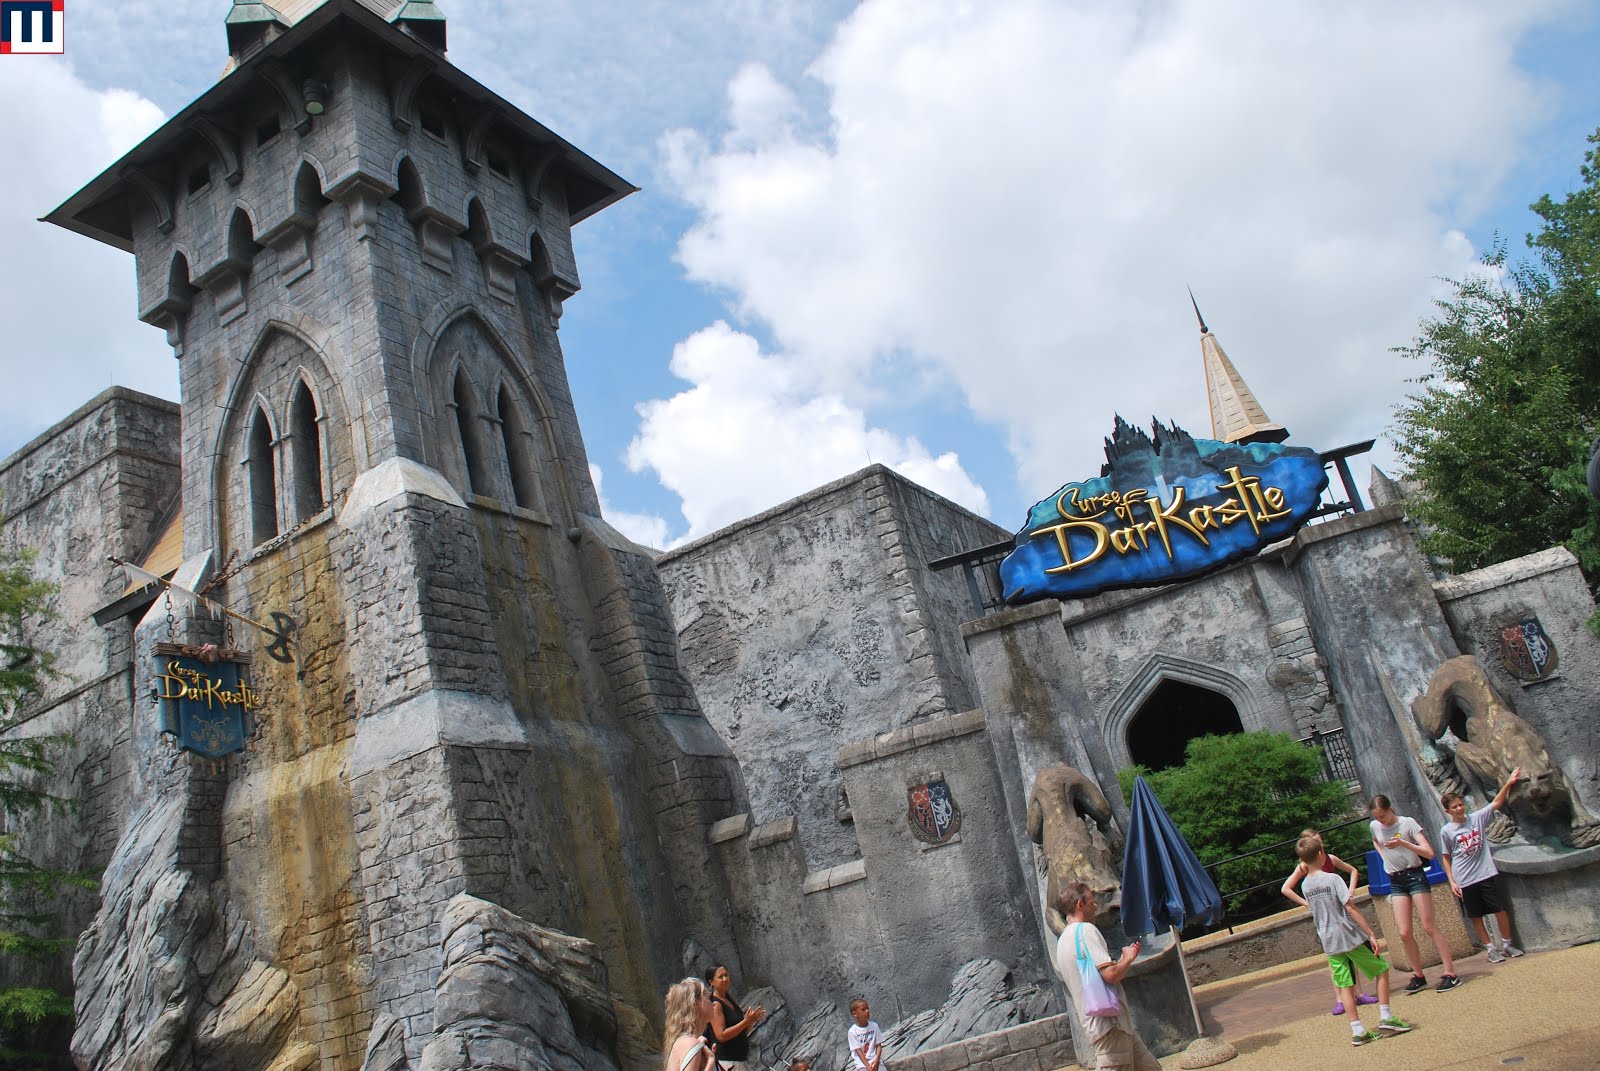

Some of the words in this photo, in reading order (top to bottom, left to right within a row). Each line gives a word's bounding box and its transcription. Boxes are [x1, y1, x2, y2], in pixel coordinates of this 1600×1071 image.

[1029, 466, 1293, 575] DarKastle
[1057, 488, 1121, 520] Curse
[1114, 488, 1148, 525] of
[167, 660, 199, 679] Curse
